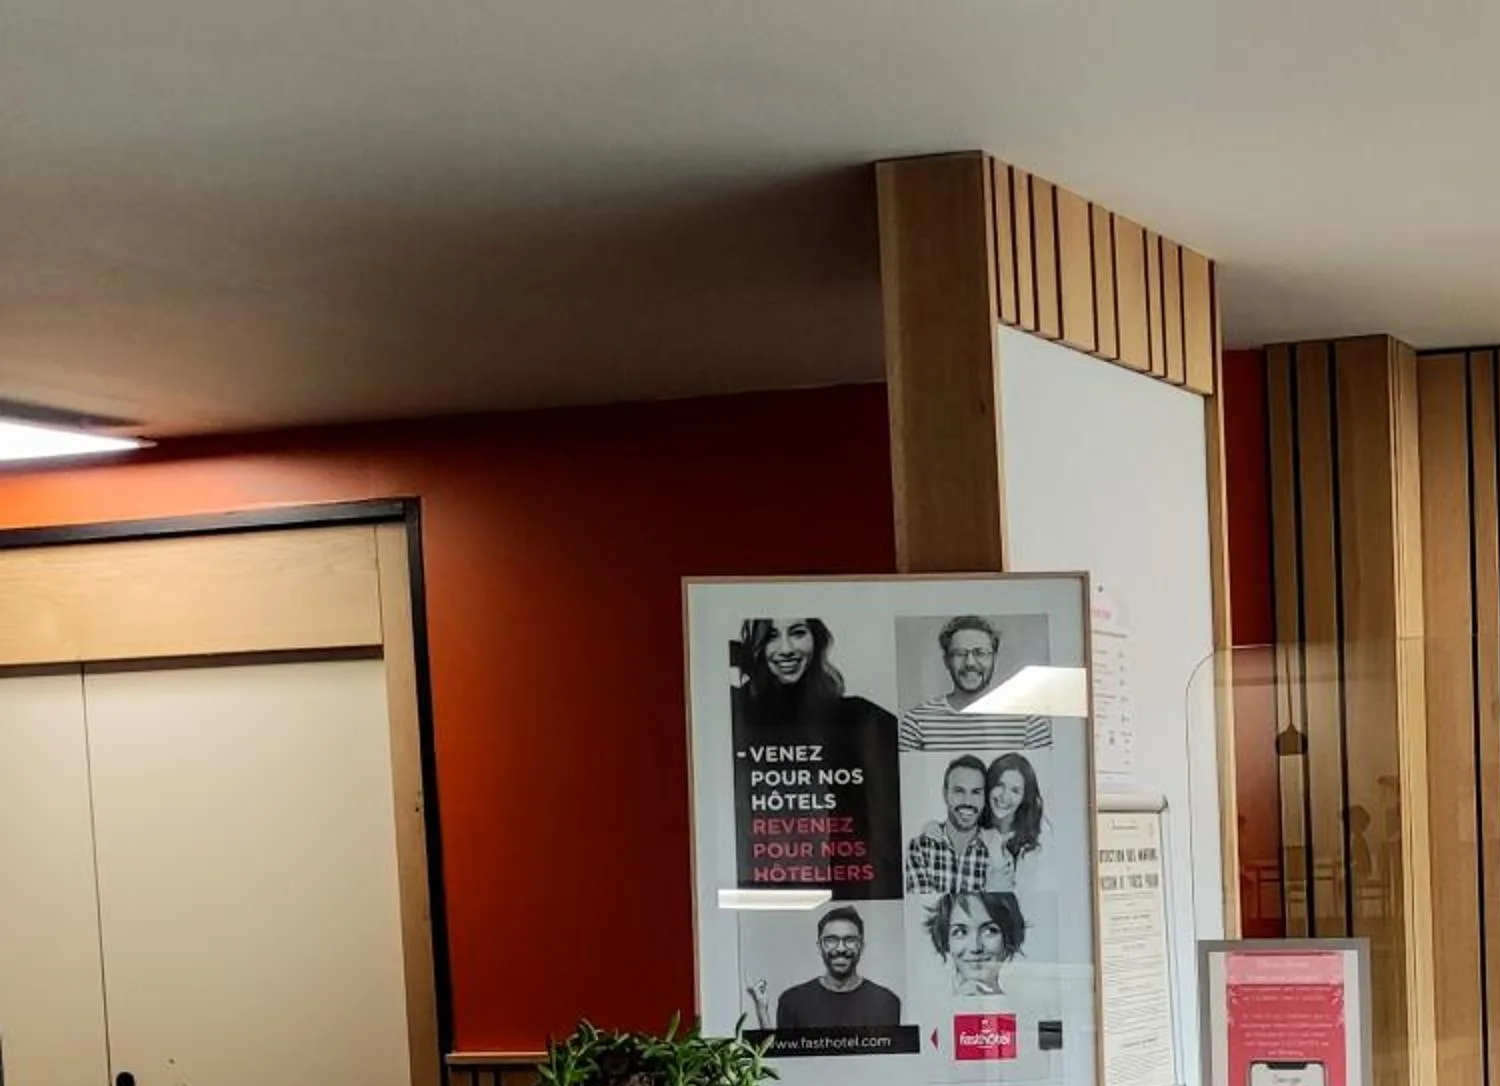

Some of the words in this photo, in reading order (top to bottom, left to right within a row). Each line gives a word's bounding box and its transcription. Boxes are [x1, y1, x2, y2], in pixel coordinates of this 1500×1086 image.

[751, 769, 812, 787] POUR
[819, 768, 865, 785] NOS
[751, 789, 837, 811] HÔTELS
[753, 816, 854, 835] REVENEZ
[753, 842, 814, 859] POUR
[820, 840, 867, 858] NOS
[753, 862, 876, 883] HÔTELIERS
[771, 1034, 892, 1050] ww.fasthotel.com
